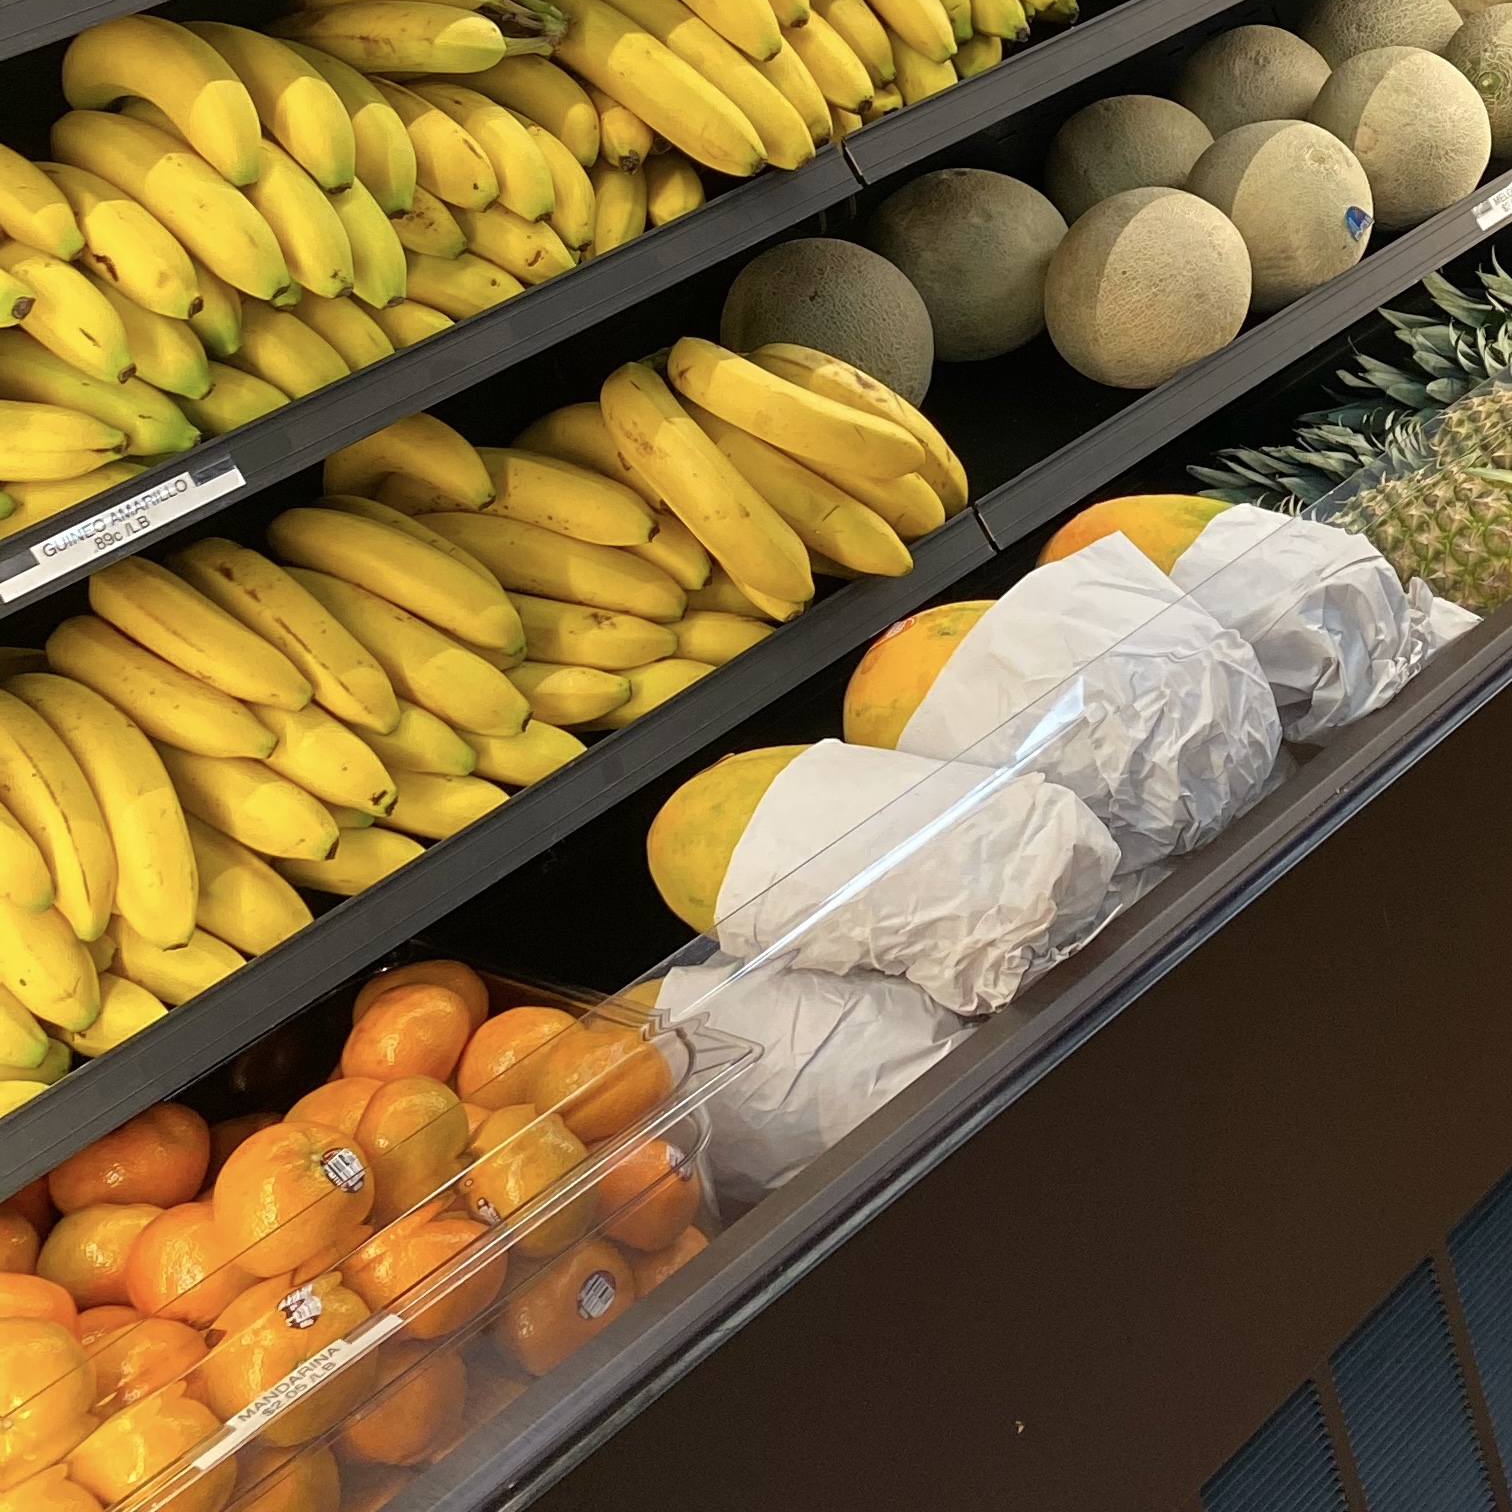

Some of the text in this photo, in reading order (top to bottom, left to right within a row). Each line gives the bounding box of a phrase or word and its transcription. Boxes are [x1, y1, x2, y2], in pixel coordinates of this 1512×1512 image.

[42, 478, 188, 558] GUINEO AMARILLO
[125, 515, 151, 537] /LB
[237, 1346, 341, 1422] MANDARINA
[260, 1361, 338, 1418] $2.05 /LB
